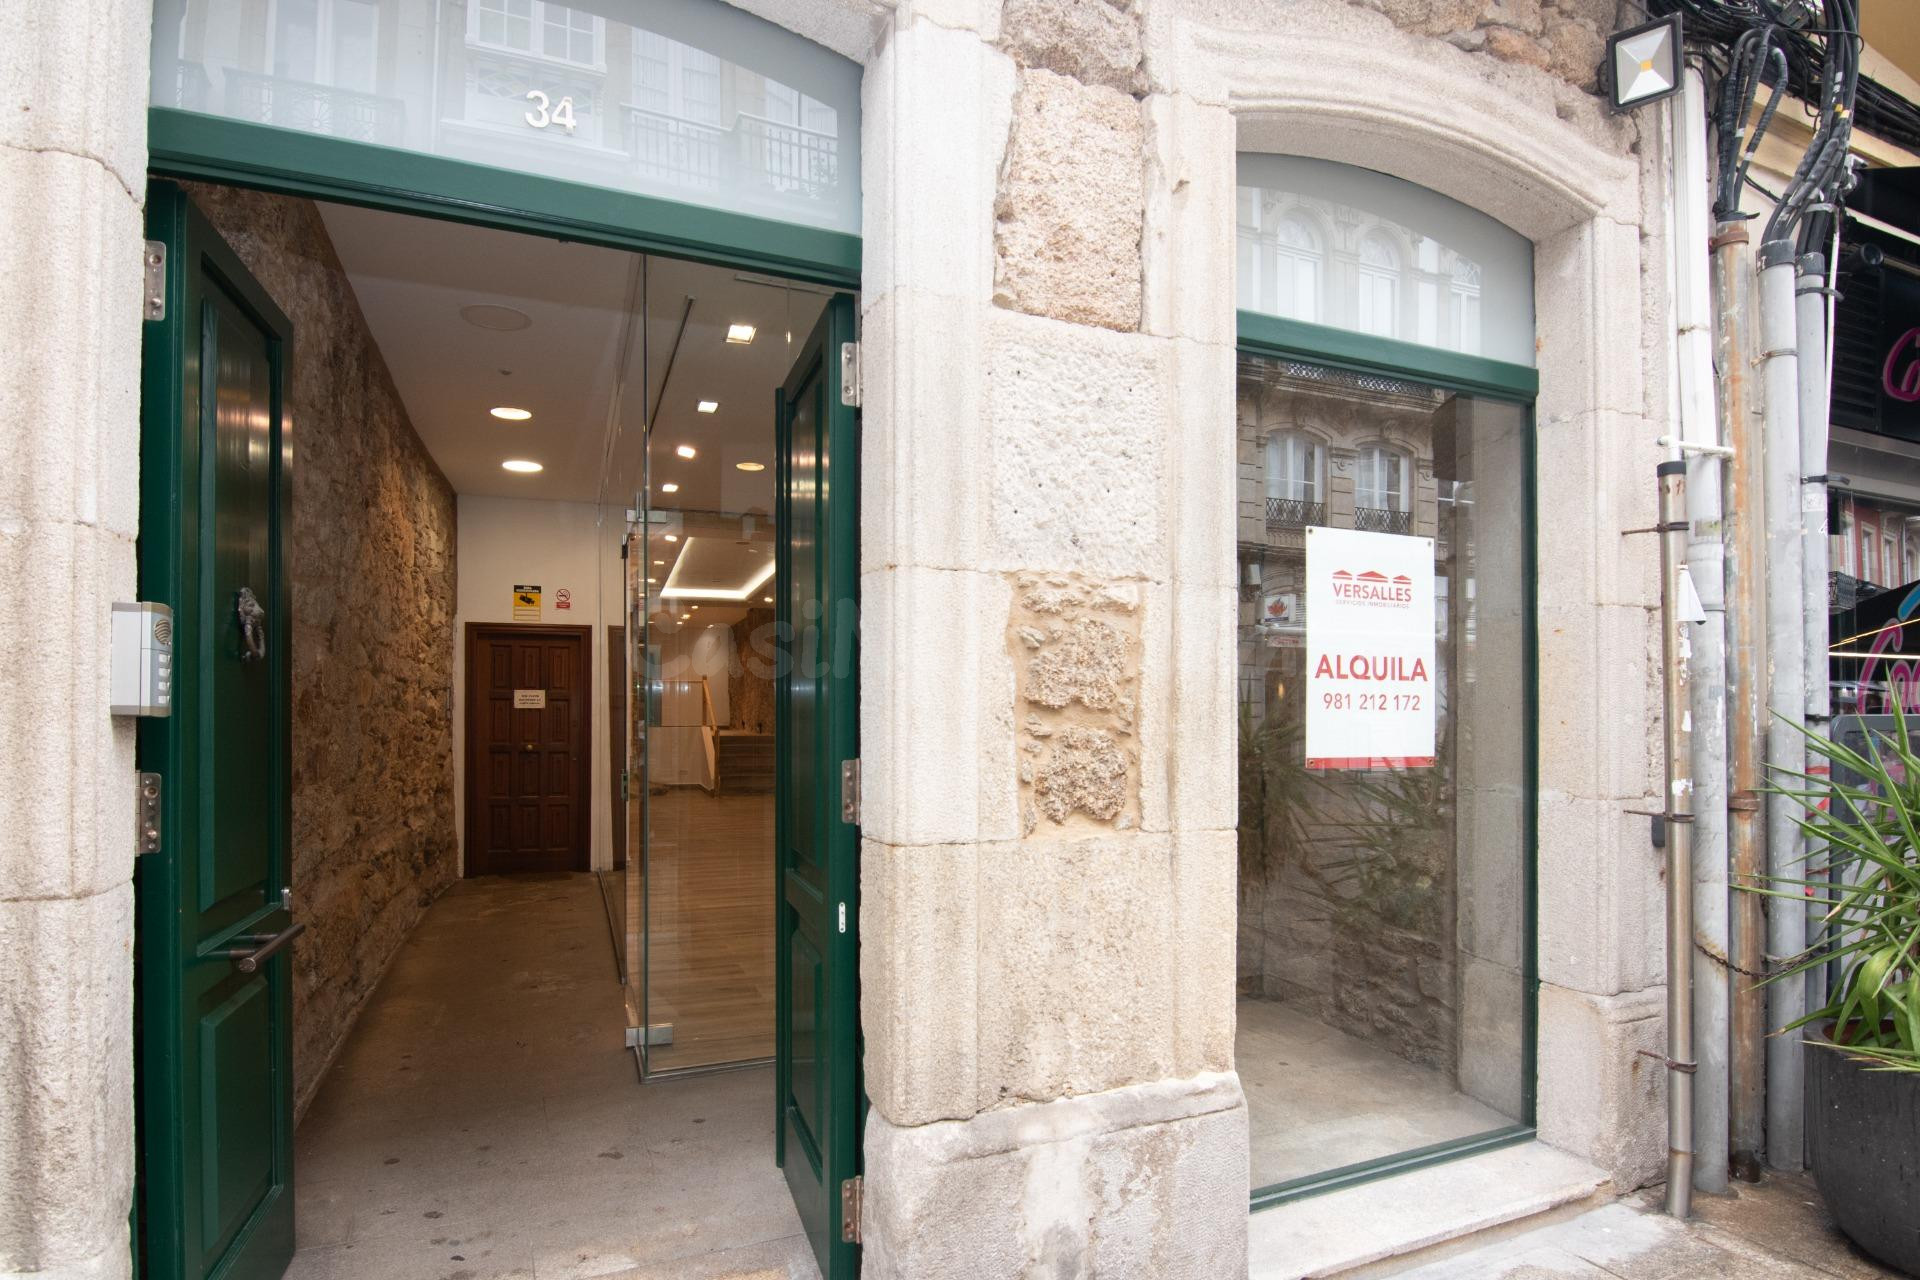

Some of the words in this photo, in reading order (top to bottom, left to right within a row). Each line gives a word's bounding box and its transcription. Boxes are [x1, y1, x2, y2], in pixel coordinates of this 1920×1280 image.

[526, 90, 576, 128] 34
[1332, 583, 1412, 602] VERSALLES
[1315, 654, 1428, 681] ALQUILA
[1323, 692, 1350, 709] 981
[1359, 693, 1387, 710] 212
[1393, 694, 1420, 711] 172
